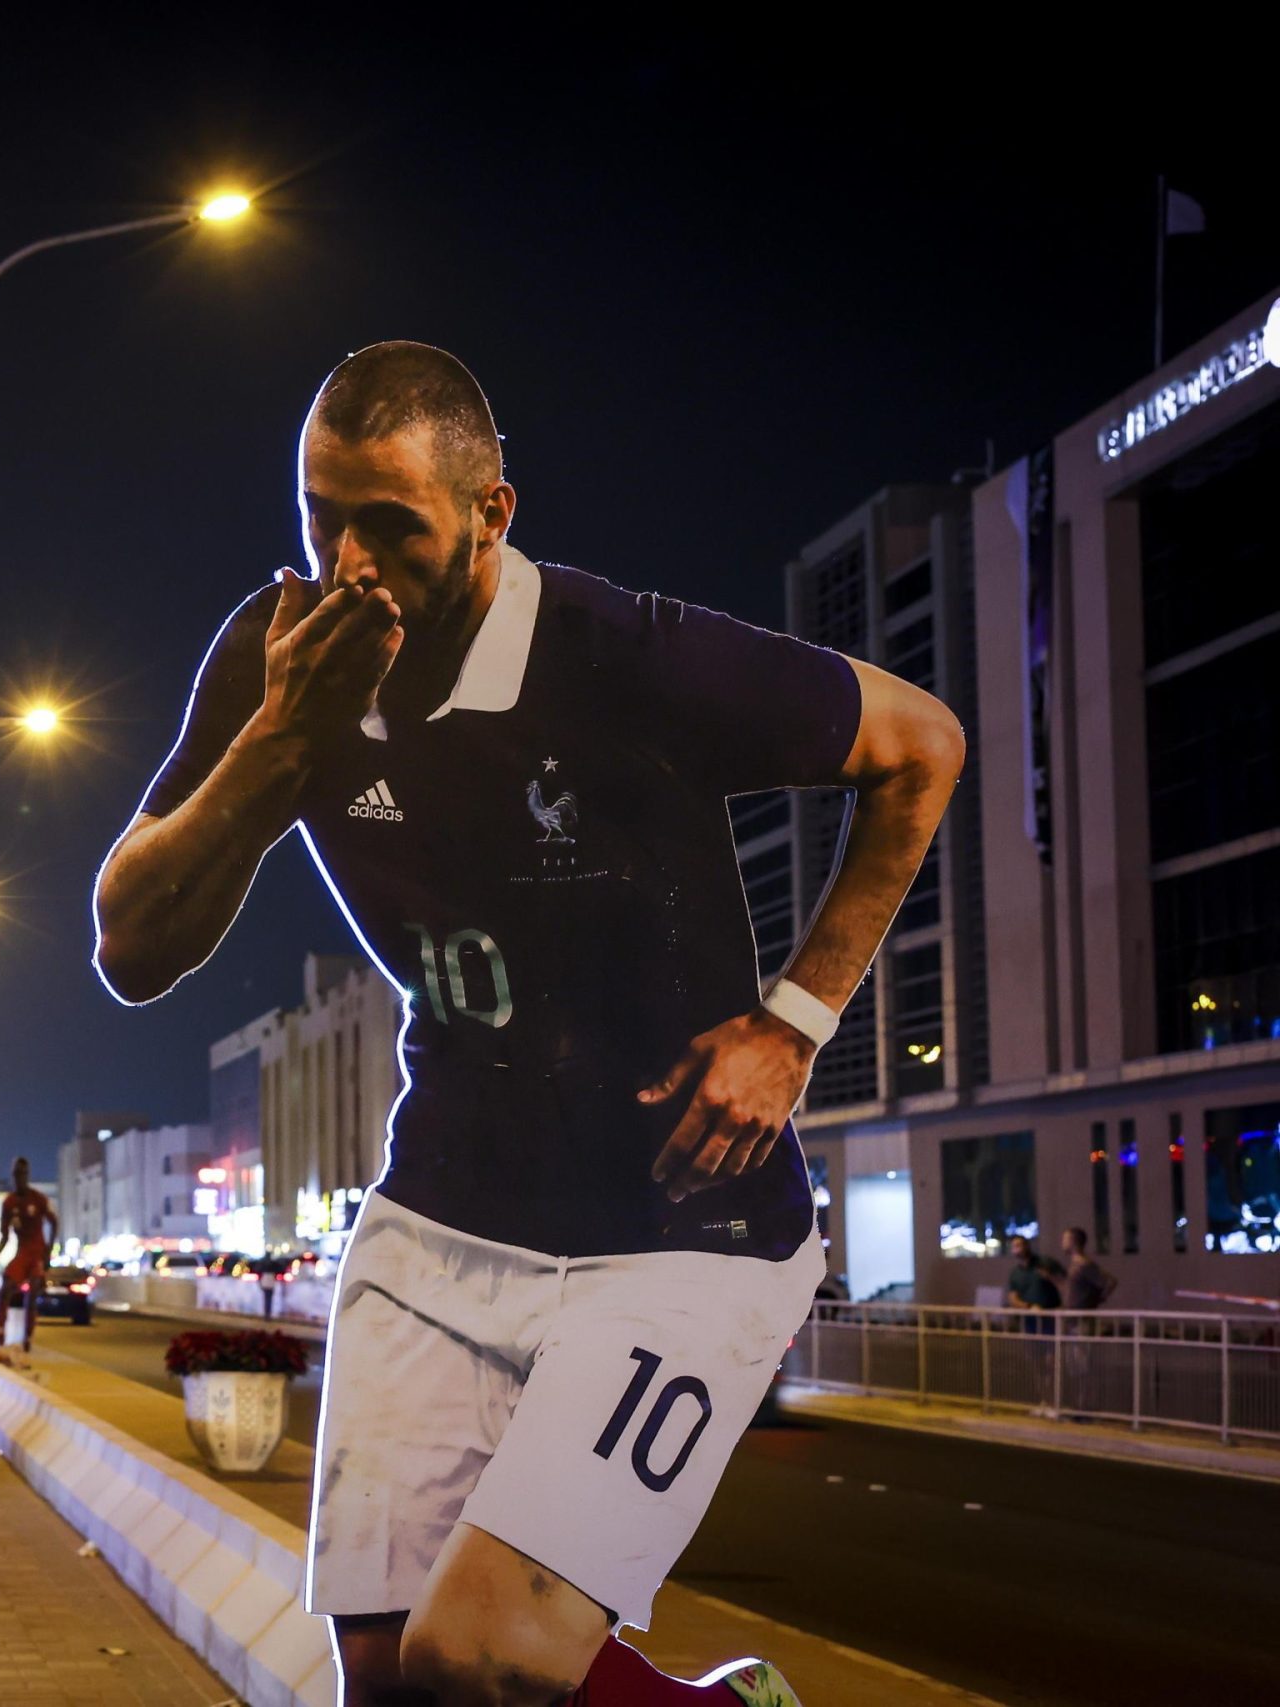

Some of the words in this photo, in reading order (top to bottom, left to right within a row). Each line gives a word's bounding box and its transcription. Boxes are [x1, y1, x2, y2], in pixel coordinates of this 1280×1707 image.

[348, 803, 404, 821] adidas
[402, 922, 512, 1029] 10
[593, 1346, 712, 1493] 10
